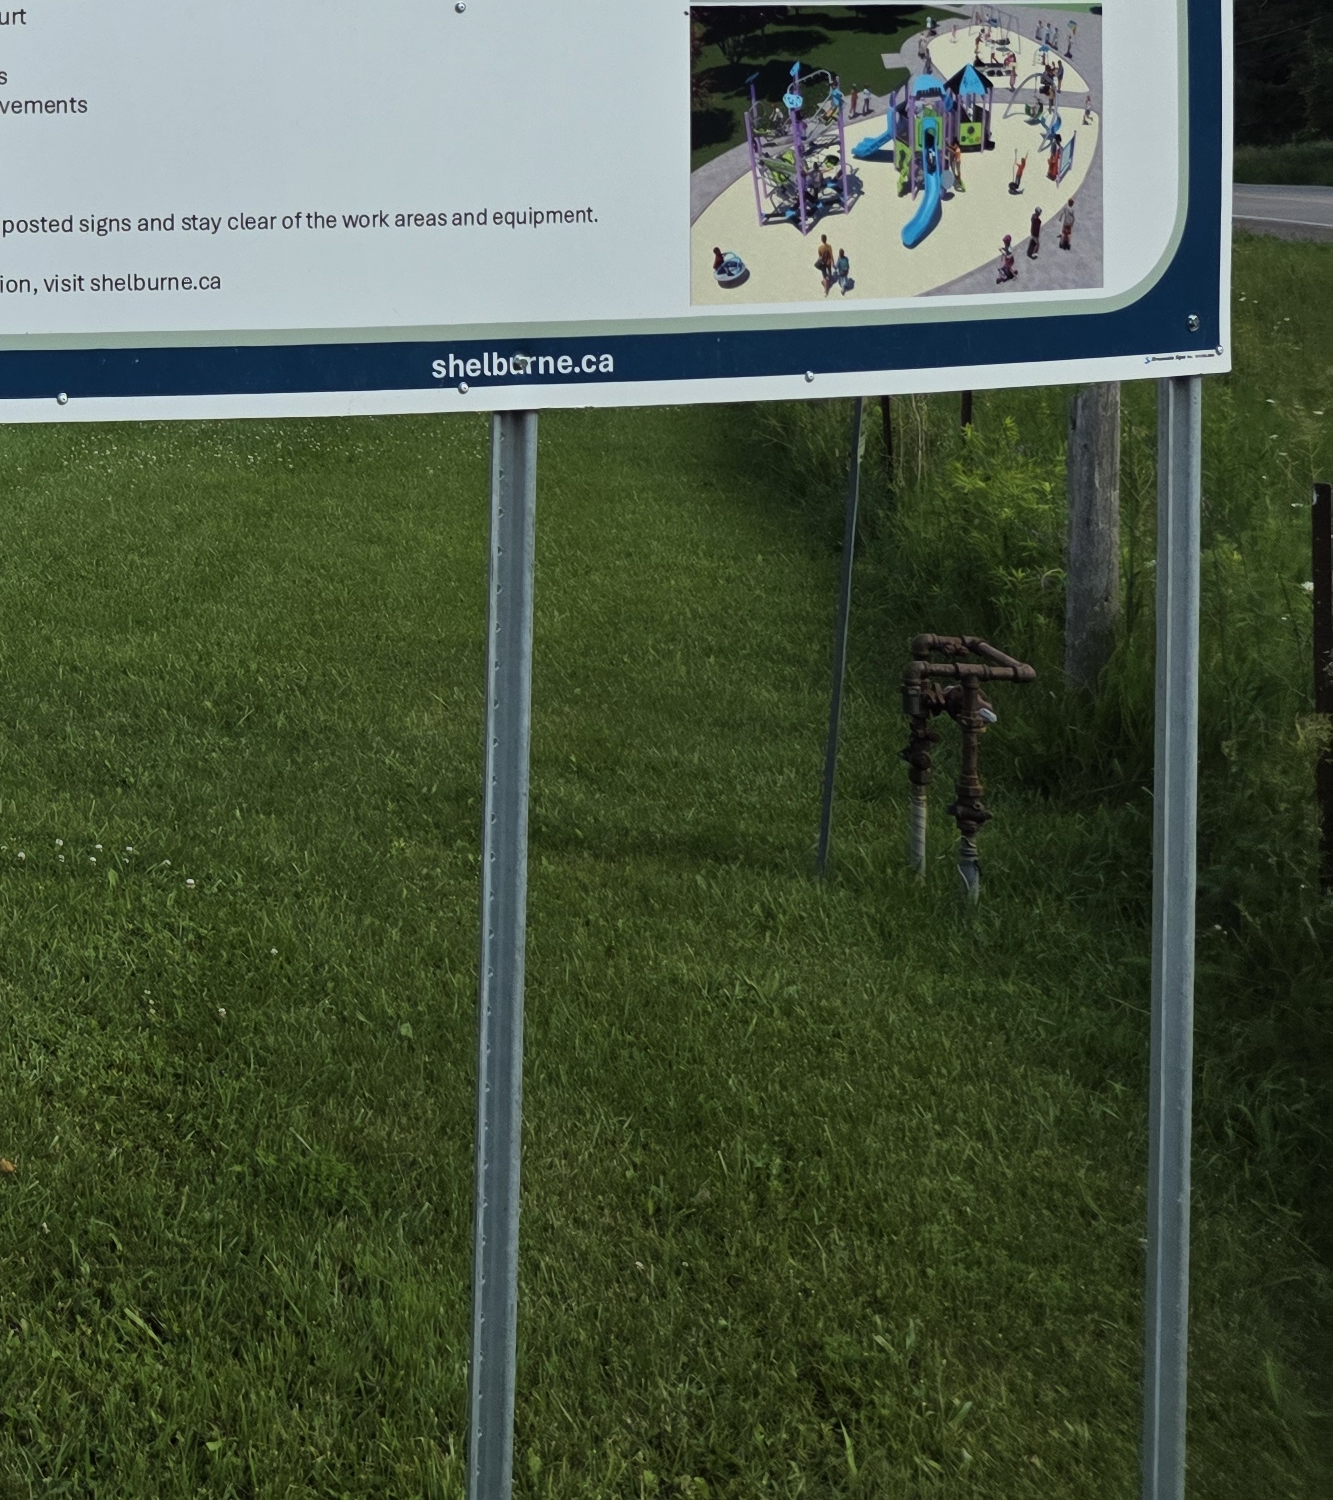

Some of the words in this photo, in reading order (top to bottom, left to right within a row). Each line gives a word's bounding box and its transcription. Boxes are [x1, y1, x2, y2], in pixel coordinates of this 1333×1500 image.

[2, 214, 74, 238] posted
[78, 213, 132, 237] signs
[137, 212, 175, 232] and
[181, 214, 222, 235] stay
[227, 212, 278, 231] clear
[281, 211, 303, 230] of
[305, 211, 337, 230] the
[341, 209, 390, 229] work
[394, 212, 448, 228] areas
[451, 207, 488, 227] and
[492, 206, 599, 230] equipment.
[43, 273, 85, 293] visit
[90, 273, 221, 292] shelburne.ca
